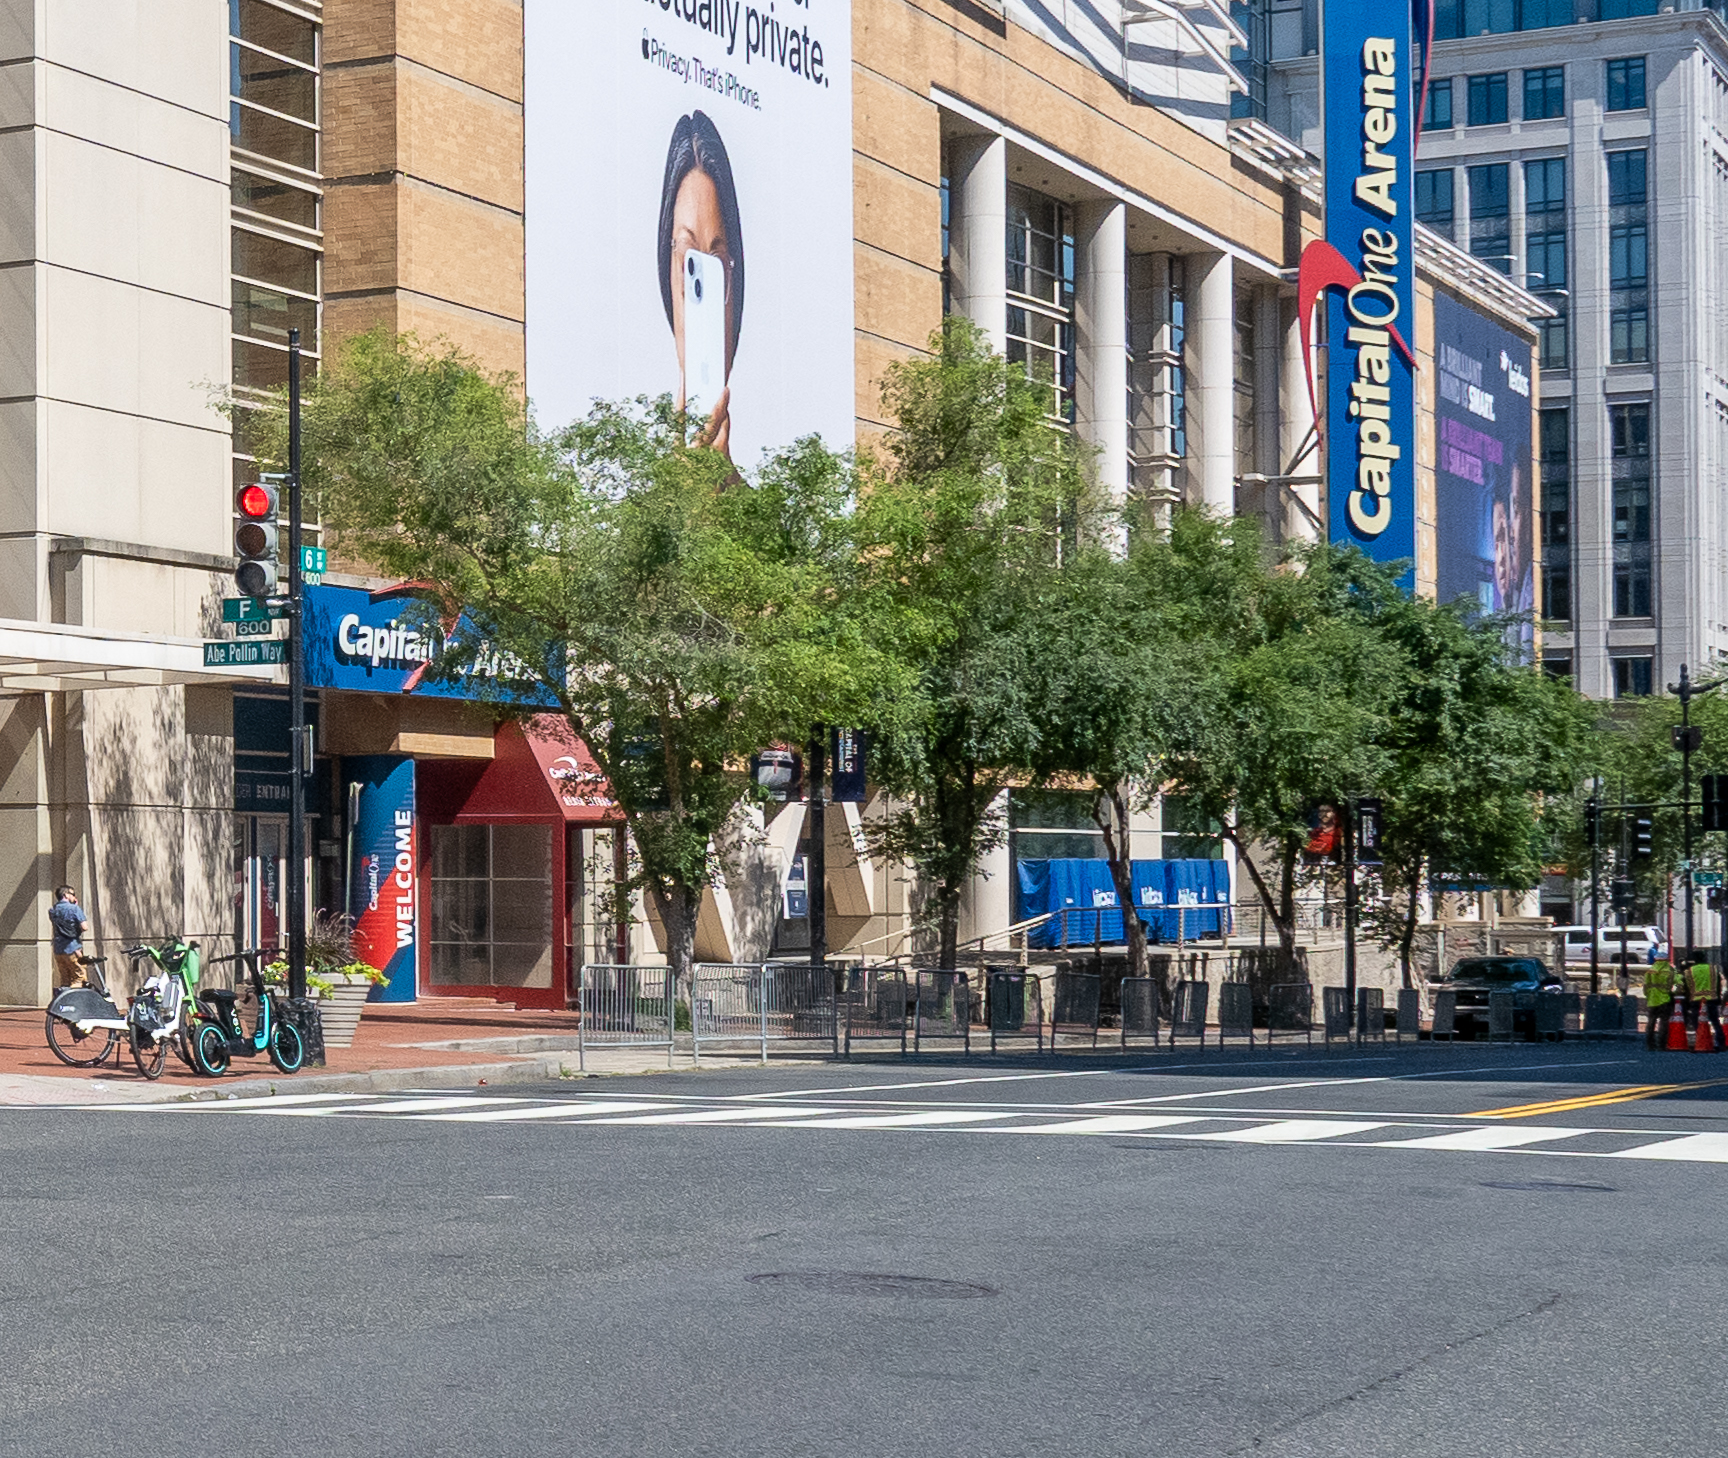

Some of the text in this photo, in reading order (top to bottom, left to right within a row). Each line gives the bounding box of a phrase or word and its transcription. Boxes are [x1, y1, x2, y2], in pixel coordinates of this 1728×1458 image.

[746, 2, 829, 88] private.
[651, 38, 762, 111] Privacy. That's iPhone.
[1355, 36, 1398, 216] Arena
[305, 549, 313, 570] 6
[238, 621, 269, 634] 600
[239, 600, 251, 618] F
[207, 642, 282, 662] Abe Pollin Way
[395, 810, 413, 948] WELCOME
